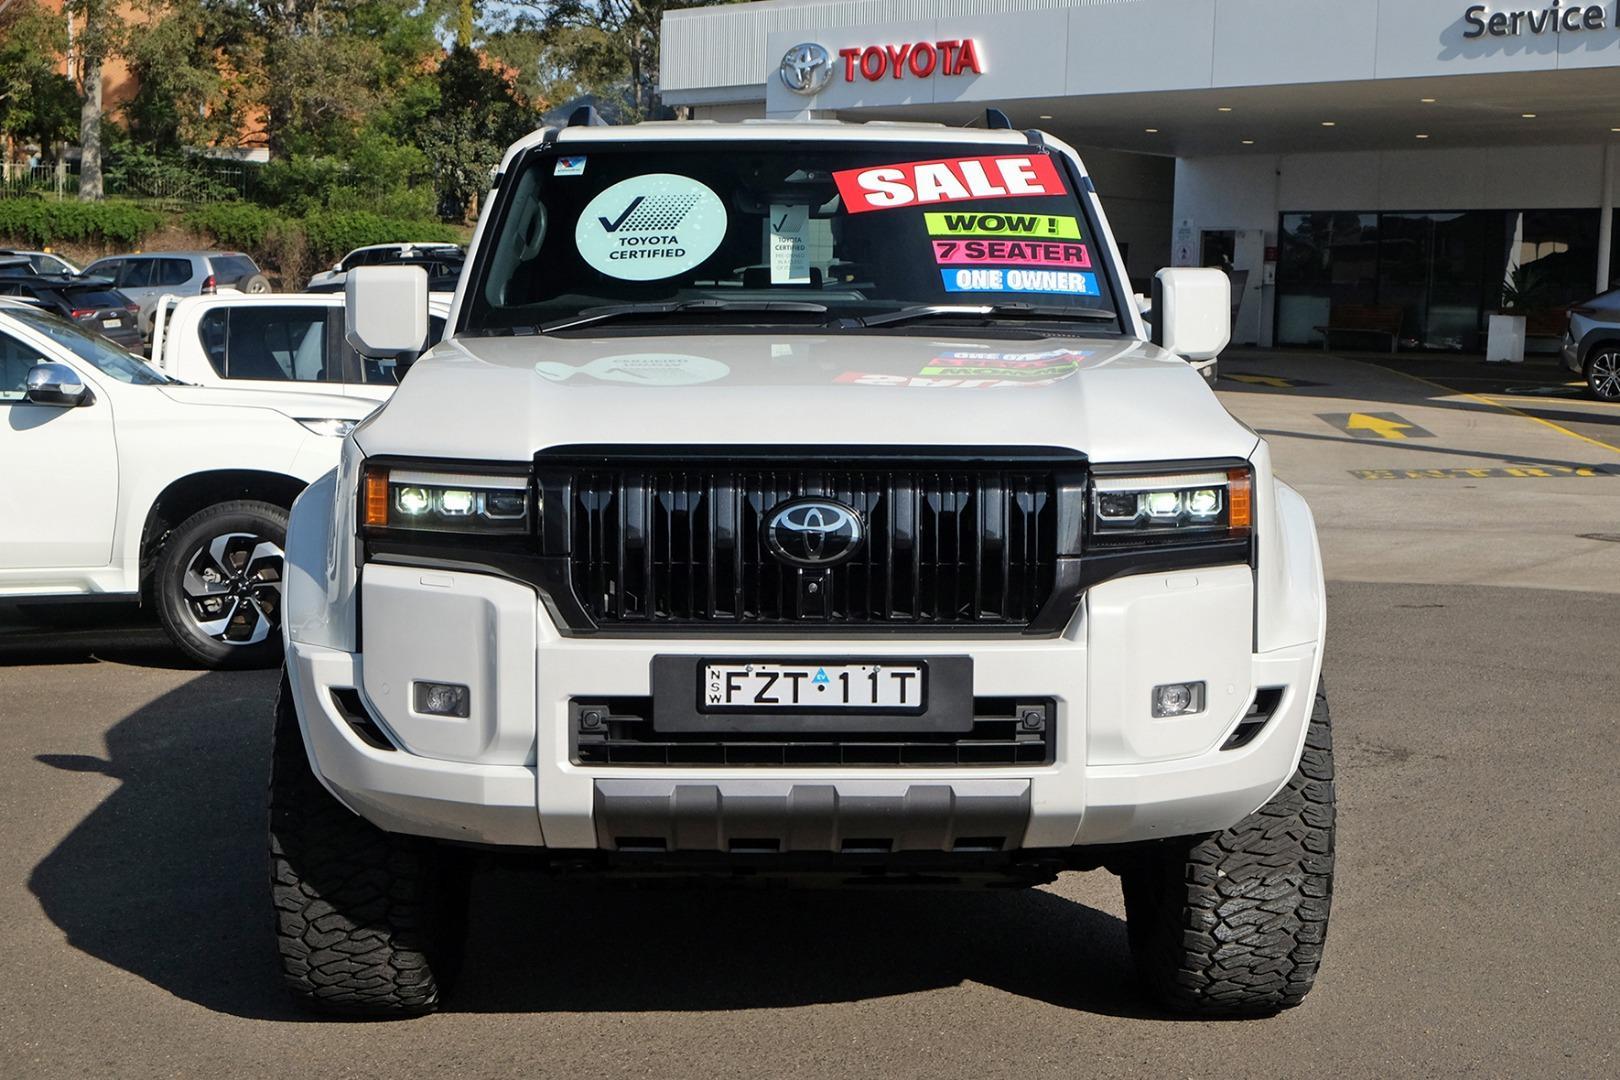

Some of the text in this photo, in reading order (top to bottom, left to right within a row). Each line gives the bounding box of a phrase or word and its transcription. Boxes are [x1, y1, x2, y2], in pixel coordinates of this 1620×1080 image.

[1463, 0, 1605, 38] Service
[839, 39, 982, 82] TOYOTA
[857, 158, 1046, 207] SALE
[943, 215, 1039, 232] WOW
[609, 248, 686, 260] CERTIFIED
[619, 235, 679, 247] TOYOTA
[936, 241, 1084, 262] 7 SEATER
[956, 269, 1087, 292] ONE OWNER
[708, 670, 723, 704] NSW
[726, 671, 916, 704] FZT 11T
